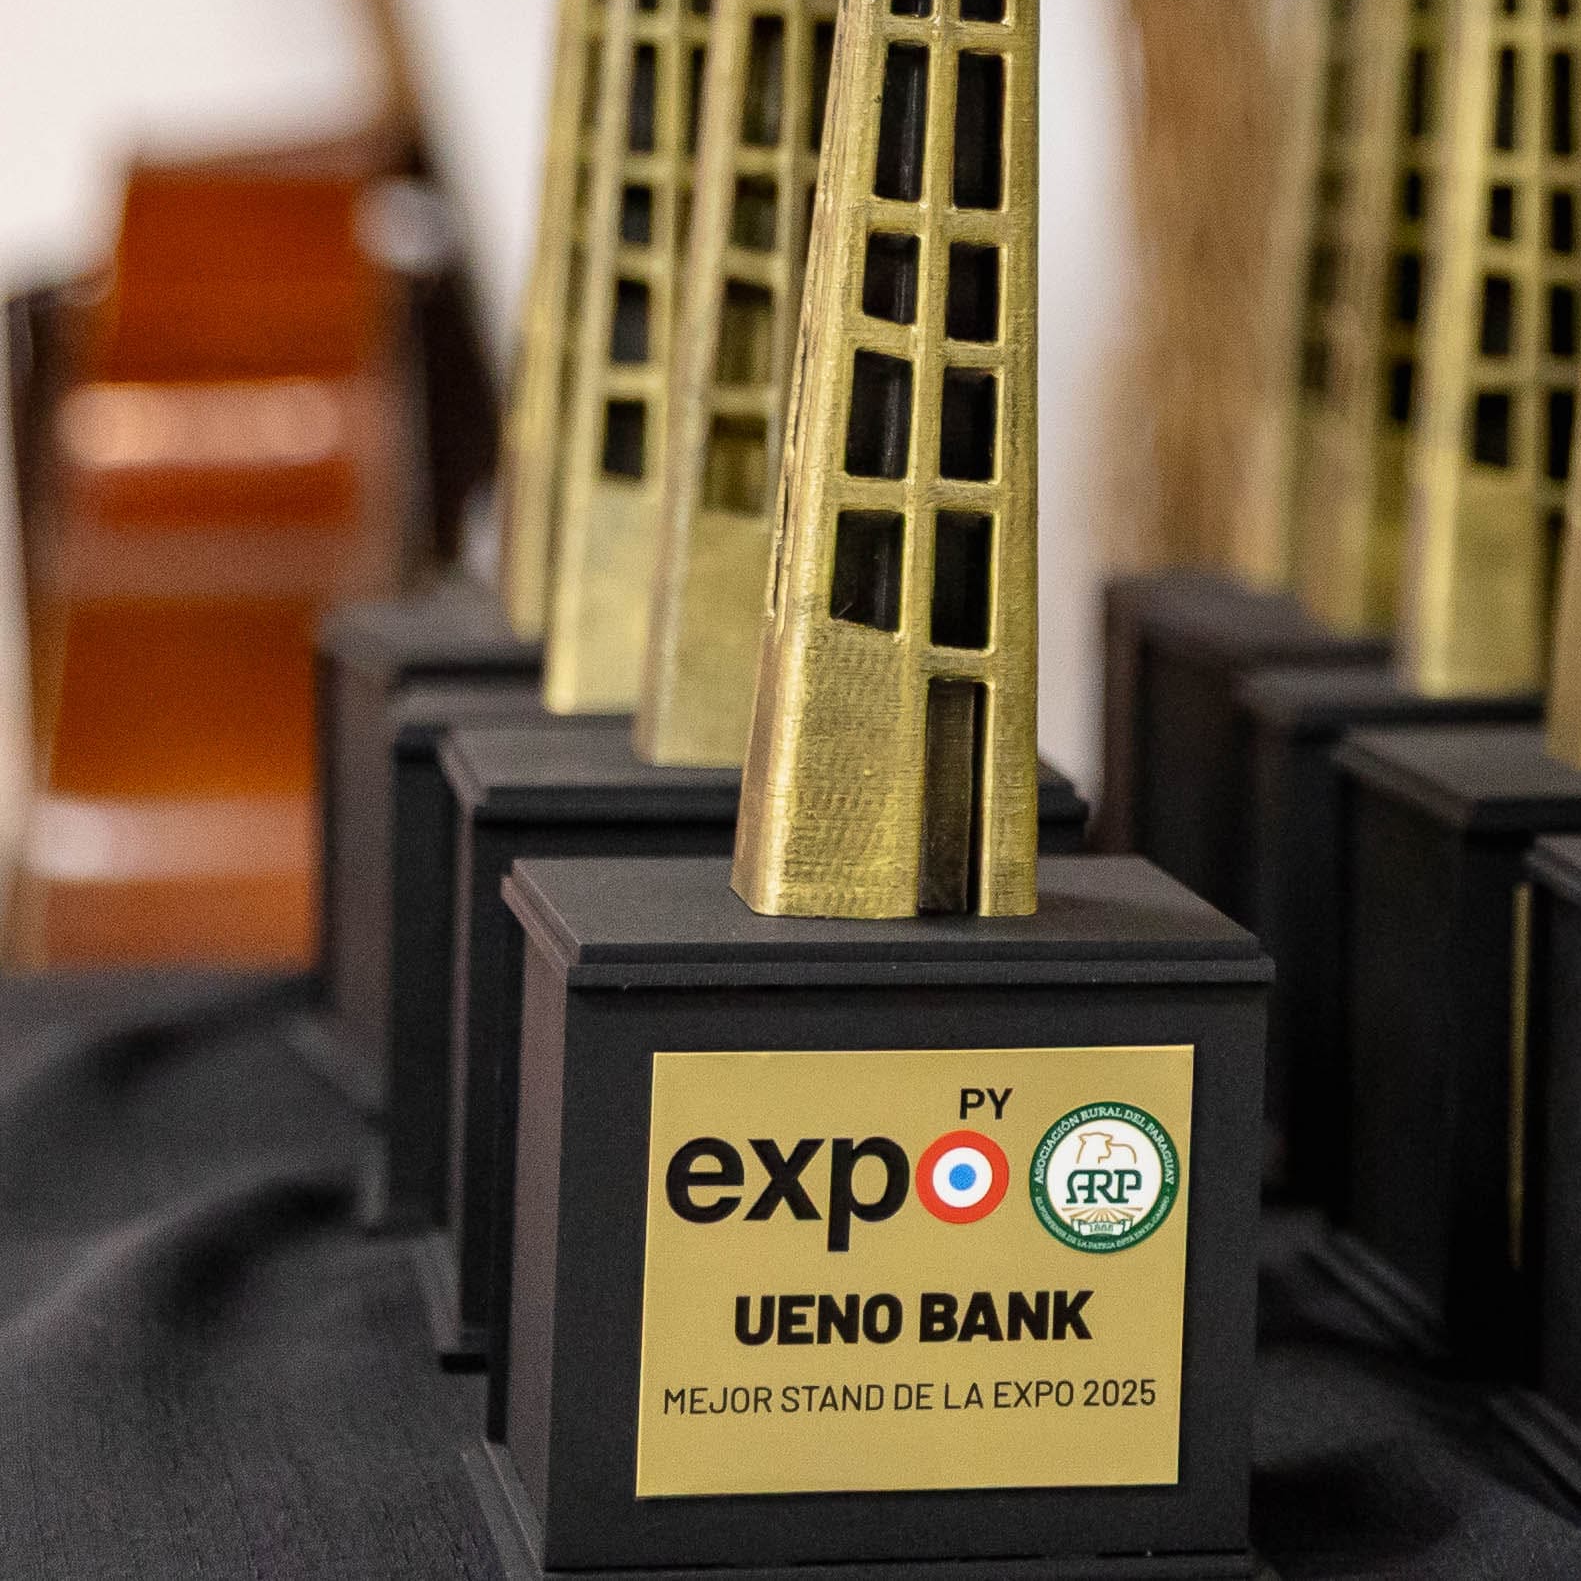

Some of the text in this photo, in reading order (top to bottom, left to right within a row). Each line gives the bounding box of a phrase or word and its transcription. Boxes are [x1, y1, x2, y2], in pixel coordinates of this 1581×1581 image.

[959, 1087, 1013, 1120] PY
[1080, 1106, 1122, 1122] RURAL
[1124, 1109, 1146, 1127] DEL
[1145, 1122, 1175, 1185] PARAGUAY
[1066, 1169, 1143, 1204] ARP
[734, 1290, 1094, 1346] UENO BANK
[664, 1378, 1156, 1415] MEJOR STAND DE LA EXPO 2025
